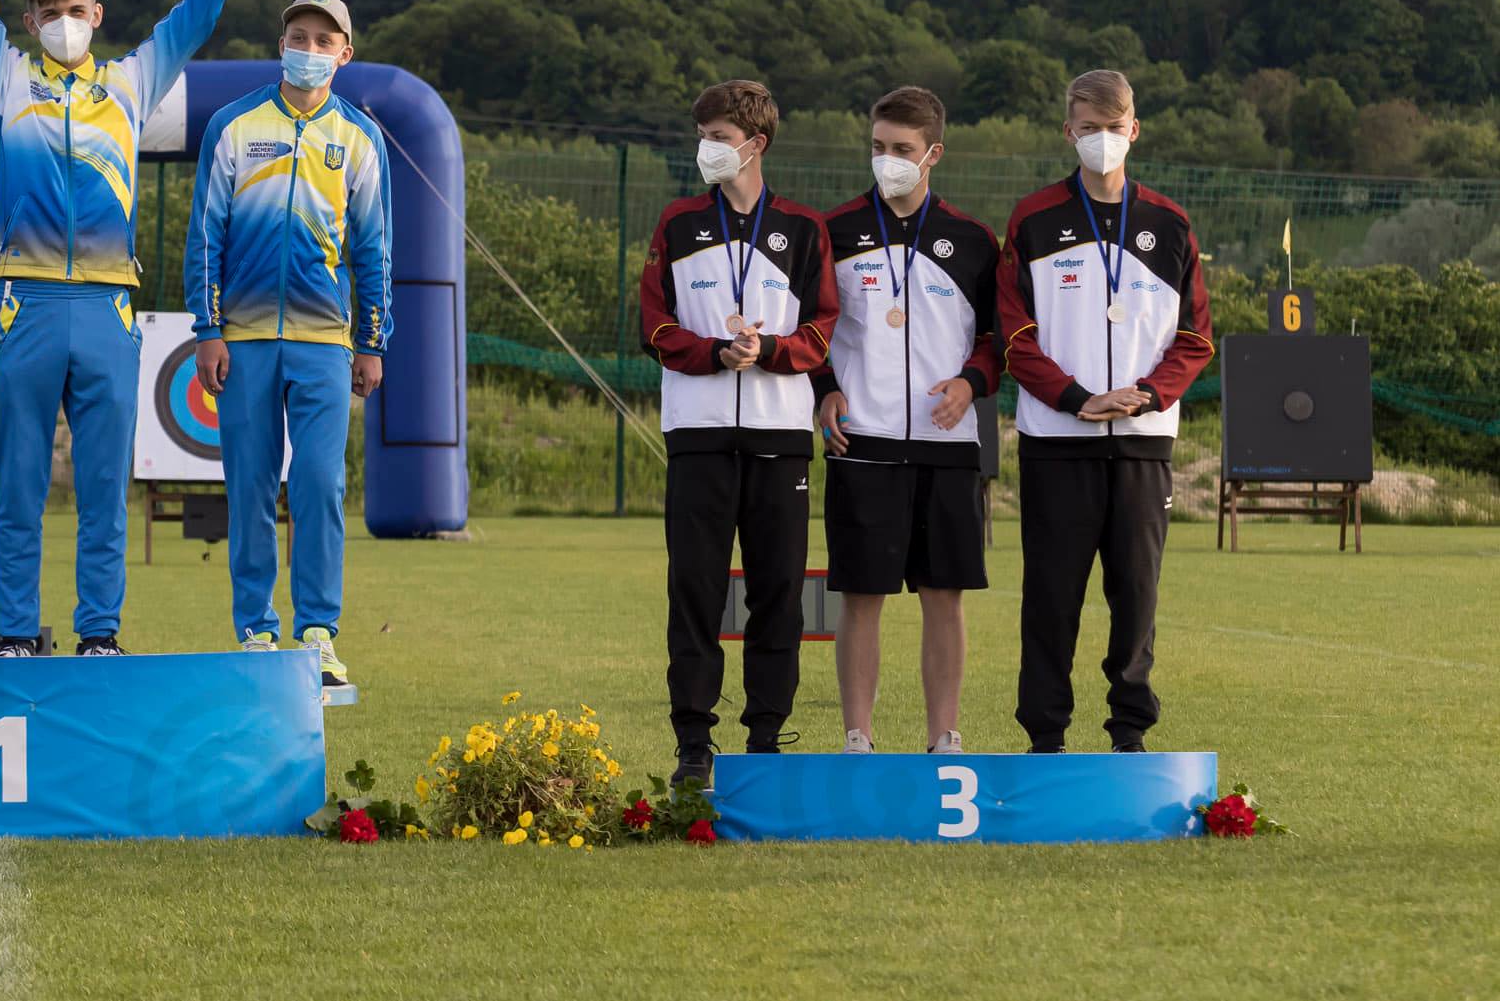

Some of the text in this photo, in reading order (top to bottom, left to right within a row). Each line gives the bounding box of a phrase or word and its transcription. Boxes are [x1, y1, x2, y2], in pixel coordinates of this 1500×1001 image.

[852, 262, 884, 271] Gothaer
[1053, 259, 1084, 268] Gothaer
[862, 277, 877, 285] 3M
[1061, 274, 1077, 283] 3M
[690, 280, 718, 289] Gothaer
[1283, 294, 1301, 332] 6
[938, 765, 979, 838] 3
